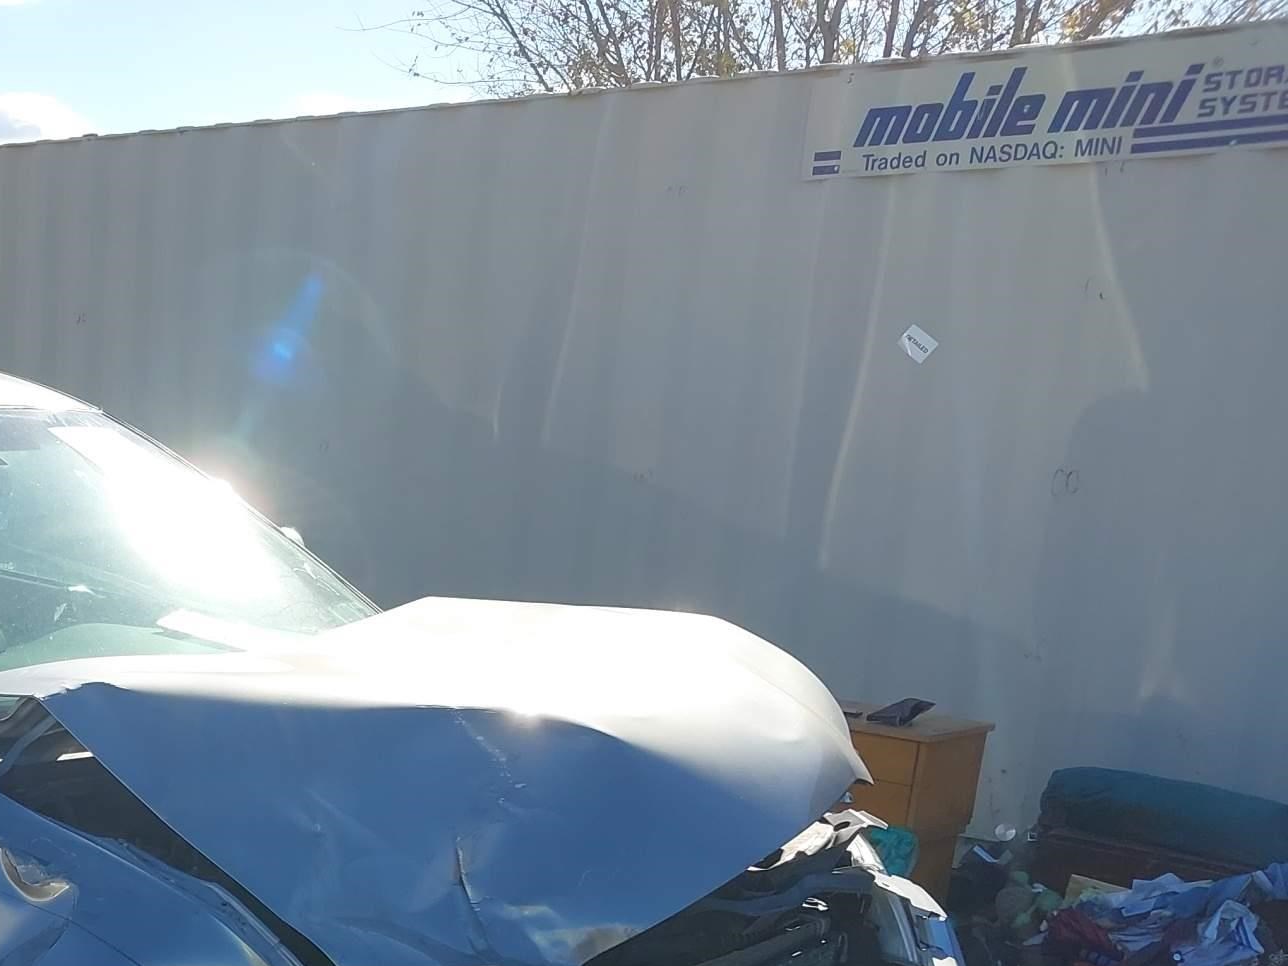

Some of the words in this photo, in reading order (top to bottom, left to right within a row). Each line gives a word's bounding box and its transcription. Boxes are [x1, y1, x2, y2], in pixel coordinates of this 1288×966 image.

[1202, 65, 1288, 93] STOR
[853, 67, 1046, 147] mobile
[1047, 63, 1205, 133] mini
[862, 150, 927, 172] Traded
[936, 152, 960, 167] on
[969, 141, 1065, 164] NASDAQ:
[1074, 136, 1123, 158] MINI
